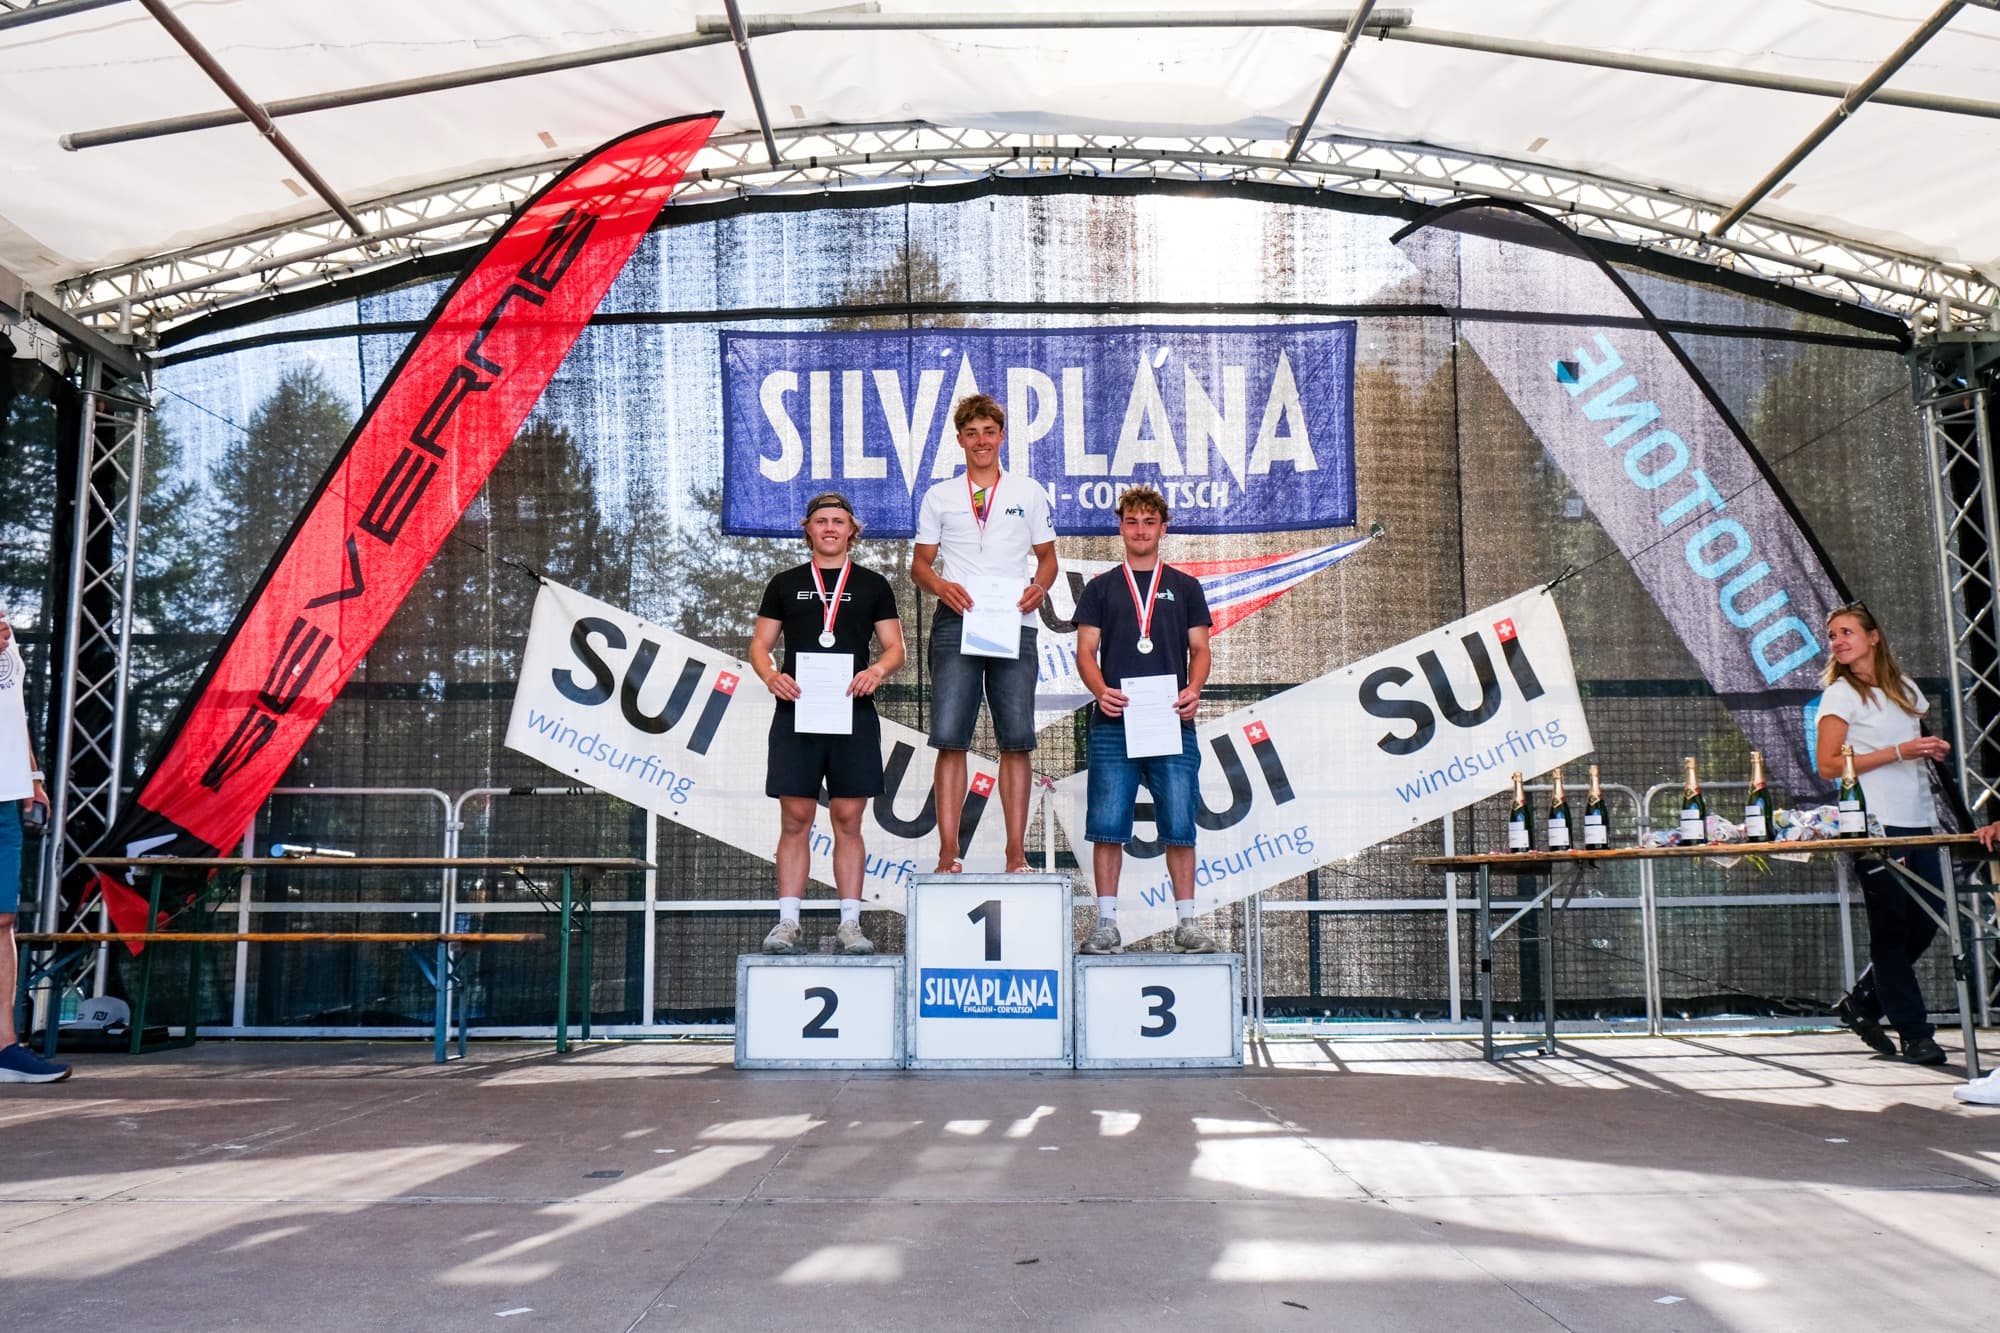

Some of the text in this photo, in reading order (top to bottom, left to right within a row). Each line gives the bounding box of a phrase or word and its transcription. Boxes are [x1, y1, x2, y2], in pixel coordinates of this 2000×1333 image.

[759, 348, 1319, 498] SILVAPLANA
[200, 207, 600, 793] SEVERNE
[1078, 481, 1229, 510] COATSCH
[528, 708, 696, 805] windsurfing
[1395, 718, 1567, 804] windsurfing
[1140, 825, 1314, 907] widsurfing
[966, 899, 1002, 961] 1
[802, 986, 839, 1038] 2
[924, 975, 1054, 1010] SILVAPLANA
[1140, 985, 1177, 1038] 3
